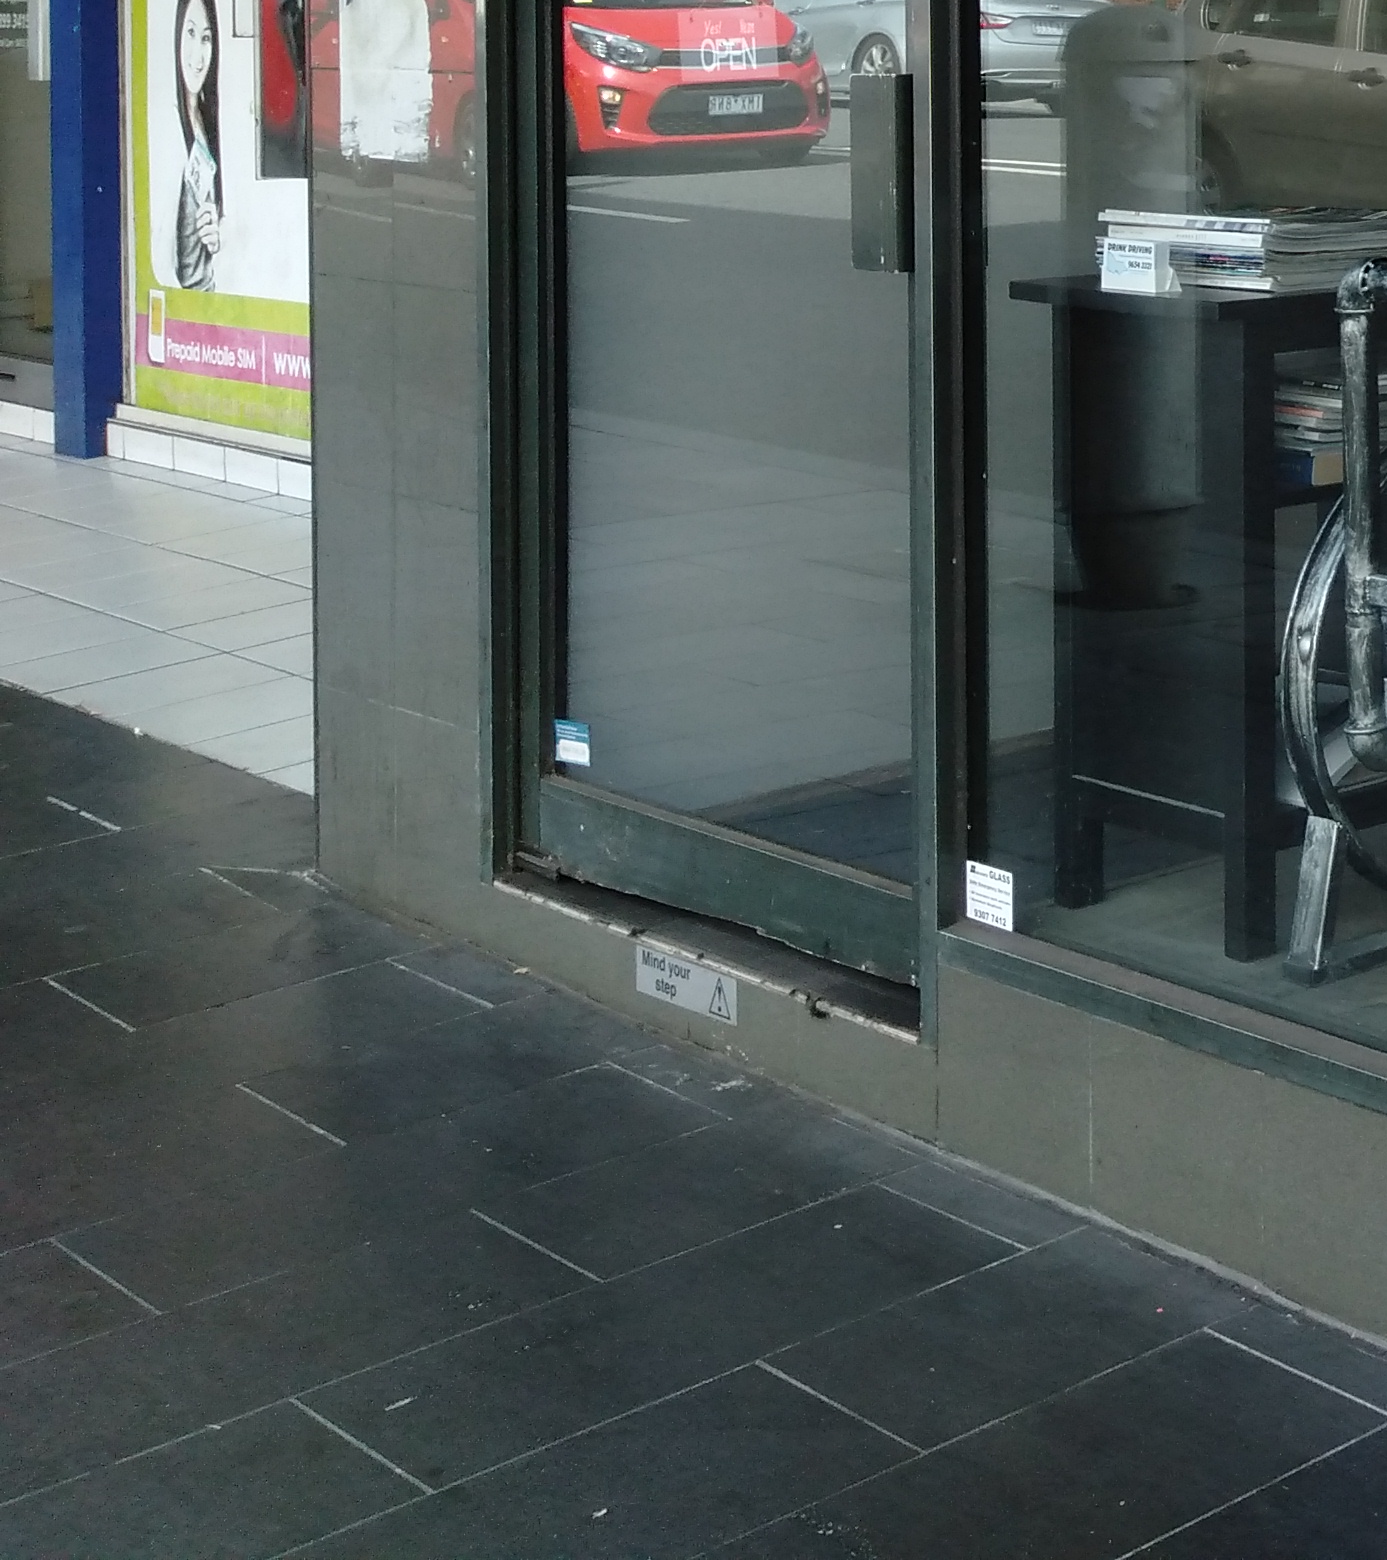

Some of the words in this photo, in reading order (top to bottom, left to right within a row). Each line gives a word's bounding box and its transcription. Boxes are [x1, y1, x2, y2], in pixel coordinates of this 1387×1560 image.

[700, 36, 758, 73] OPEN
[1107, 242, 1128, 252] DRINK
[1128, 244, 1153, 255] DRIVING
[166, 338, 201, 364] Prepaid
[202, 344, 236, 368] Mobile
[237, 347, 257, 370] SIM
[989, 870, 1011, 885] GLASS
[991, 914, 1007, 927] 7412
[641, 949, 666, 972] Mind
[668, 962, 691, 981] your
[655, 978, 677, 1000] step
